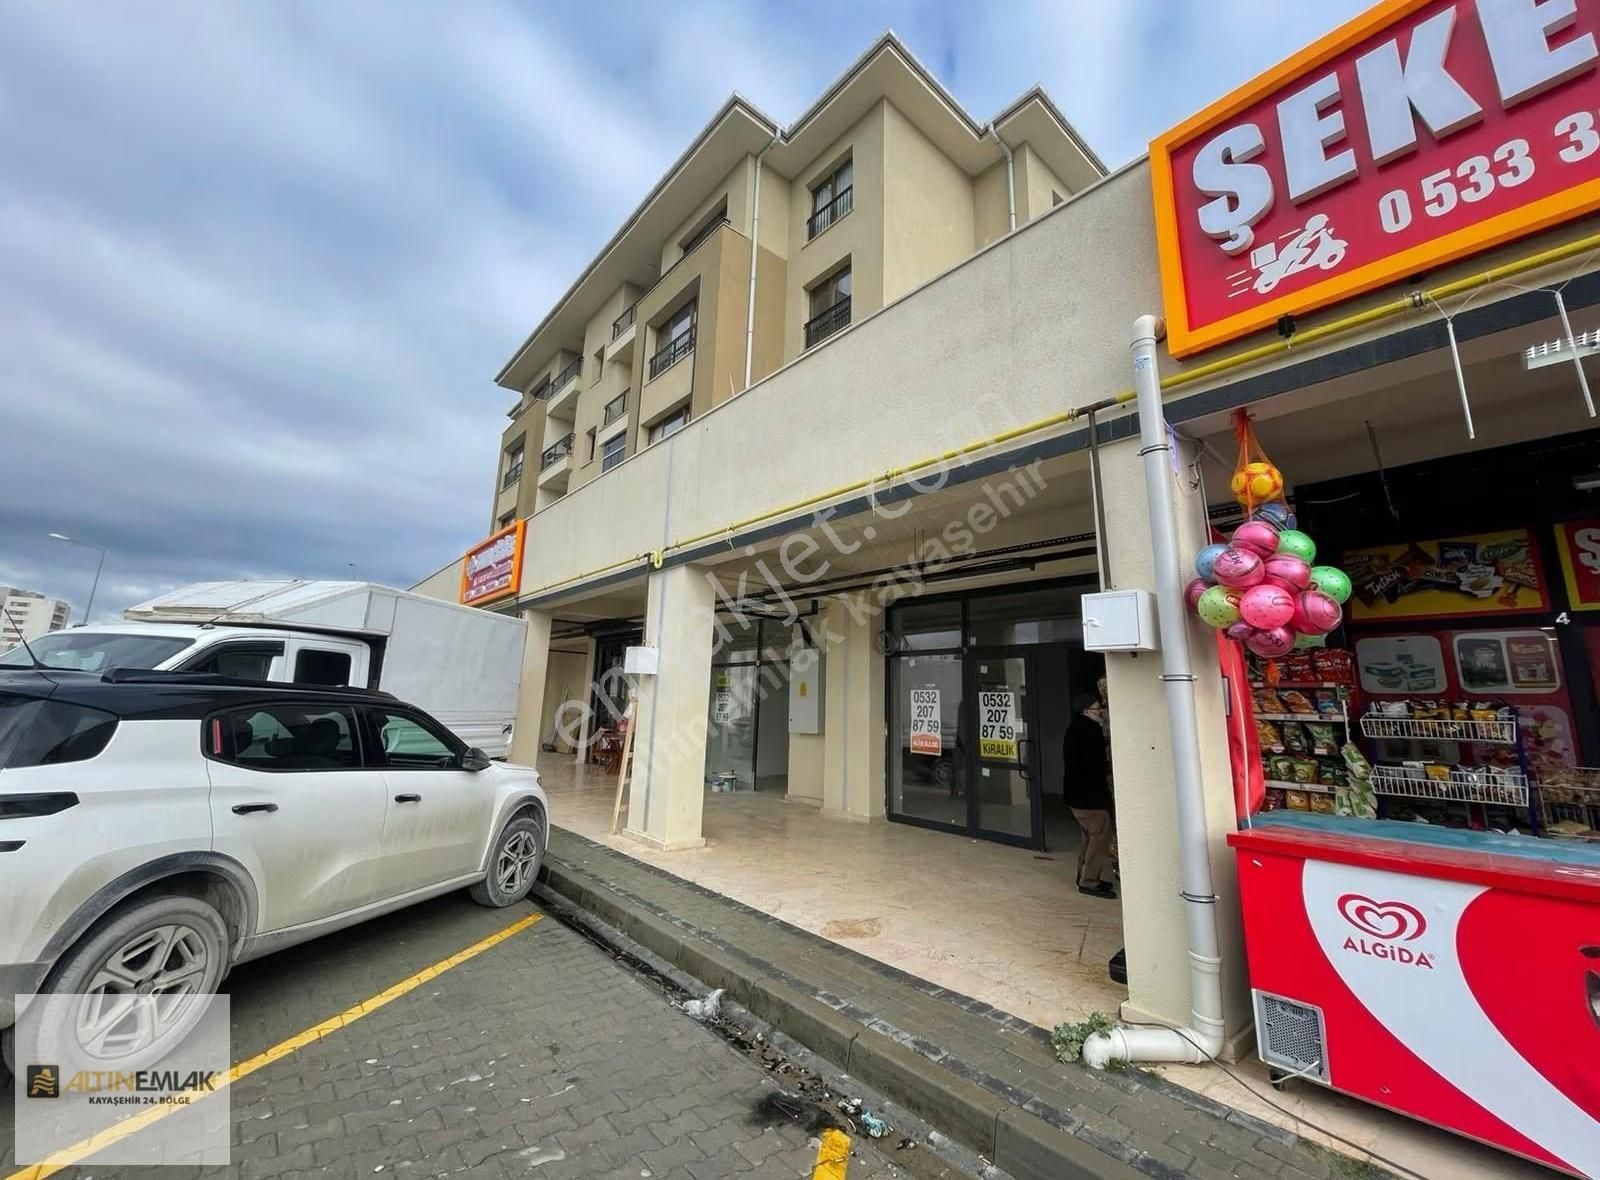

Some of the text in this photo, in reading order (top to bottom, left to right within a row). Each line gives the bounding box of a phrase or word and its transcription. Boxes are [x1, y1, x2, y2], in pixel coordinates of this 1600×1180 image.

[1379, 189, 1412, 234] 0
[1422, 138, 1535, 218] 533
[913, 691, 937, 704] 0532
[982, 693, 1011, 707] 0532
[916, 705, 935, 718] 207
[987, 709, 1008, 723] 207
[912, 719, 940, 733] 87 59
[981, 725, 1014, 740] 87 59
